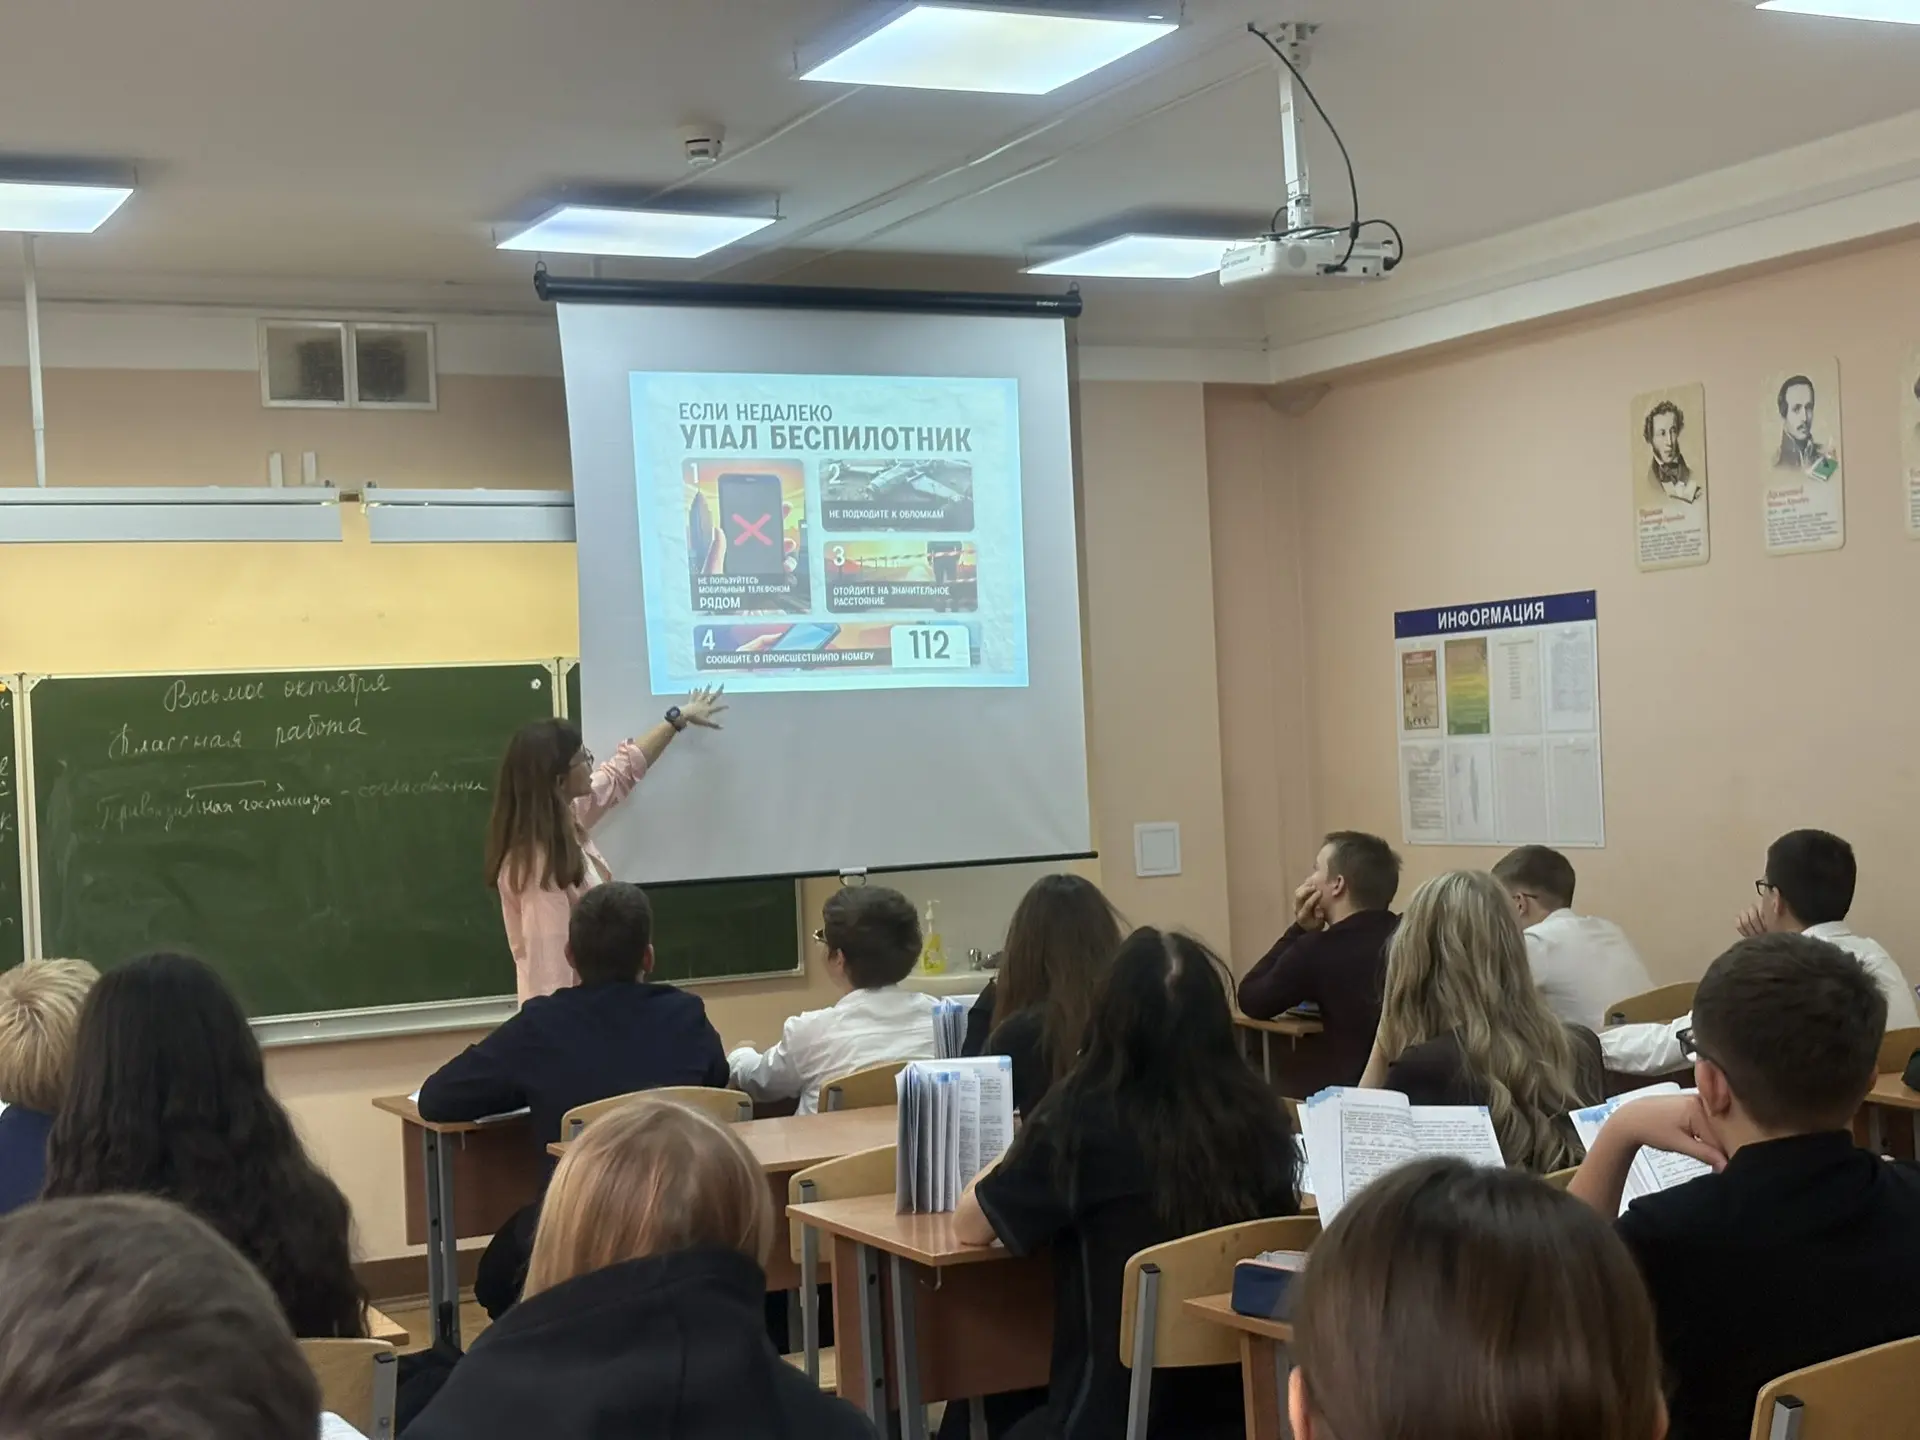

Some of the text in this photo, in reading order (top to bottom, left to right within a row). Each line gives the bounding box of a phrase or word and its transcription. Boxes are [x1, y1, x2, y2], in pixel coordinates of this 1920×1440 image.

[679, 402, 833, 423] ЕСЛИ НЕДАЛЕКО
[680, 424, 973, 452] УПАЛ БЕСПИЛОТНИК
[690, 462, 700, 484] 1
[828, 463, 841, 485] 2
[829, 509, 944, 520] НЕ ПОДХОДИТЕ К ОБЛОМКАМ
[832, 546, 845, 566] 3
[698, 576, 759, 585] НЕ ПОЛЬЗУЙТЕСЬ
[699, 585, 790, 594] МОБИЛЬНЫМ ТЕЛЕФОНОМ
[833, 585, 950, 596] ОТОЙДИТЕ НА ЗНАЧИТЕЛЬНОЕ
[700, 596, 741, 609] РЯДОМ
[834, 597, 885, 606] РАССТОЯНИЕ
[1438, 601, 1544, 629] ИНФОРМАЦИЯ
[702, 629, 715, 650] 4
[908, 630, 950, 659] 112
[706, 654, 751, 664] СООБЩИТЕ
[842, 652, 875, 661] НОМЕРУ
[275, 714, 368, 748] работа
